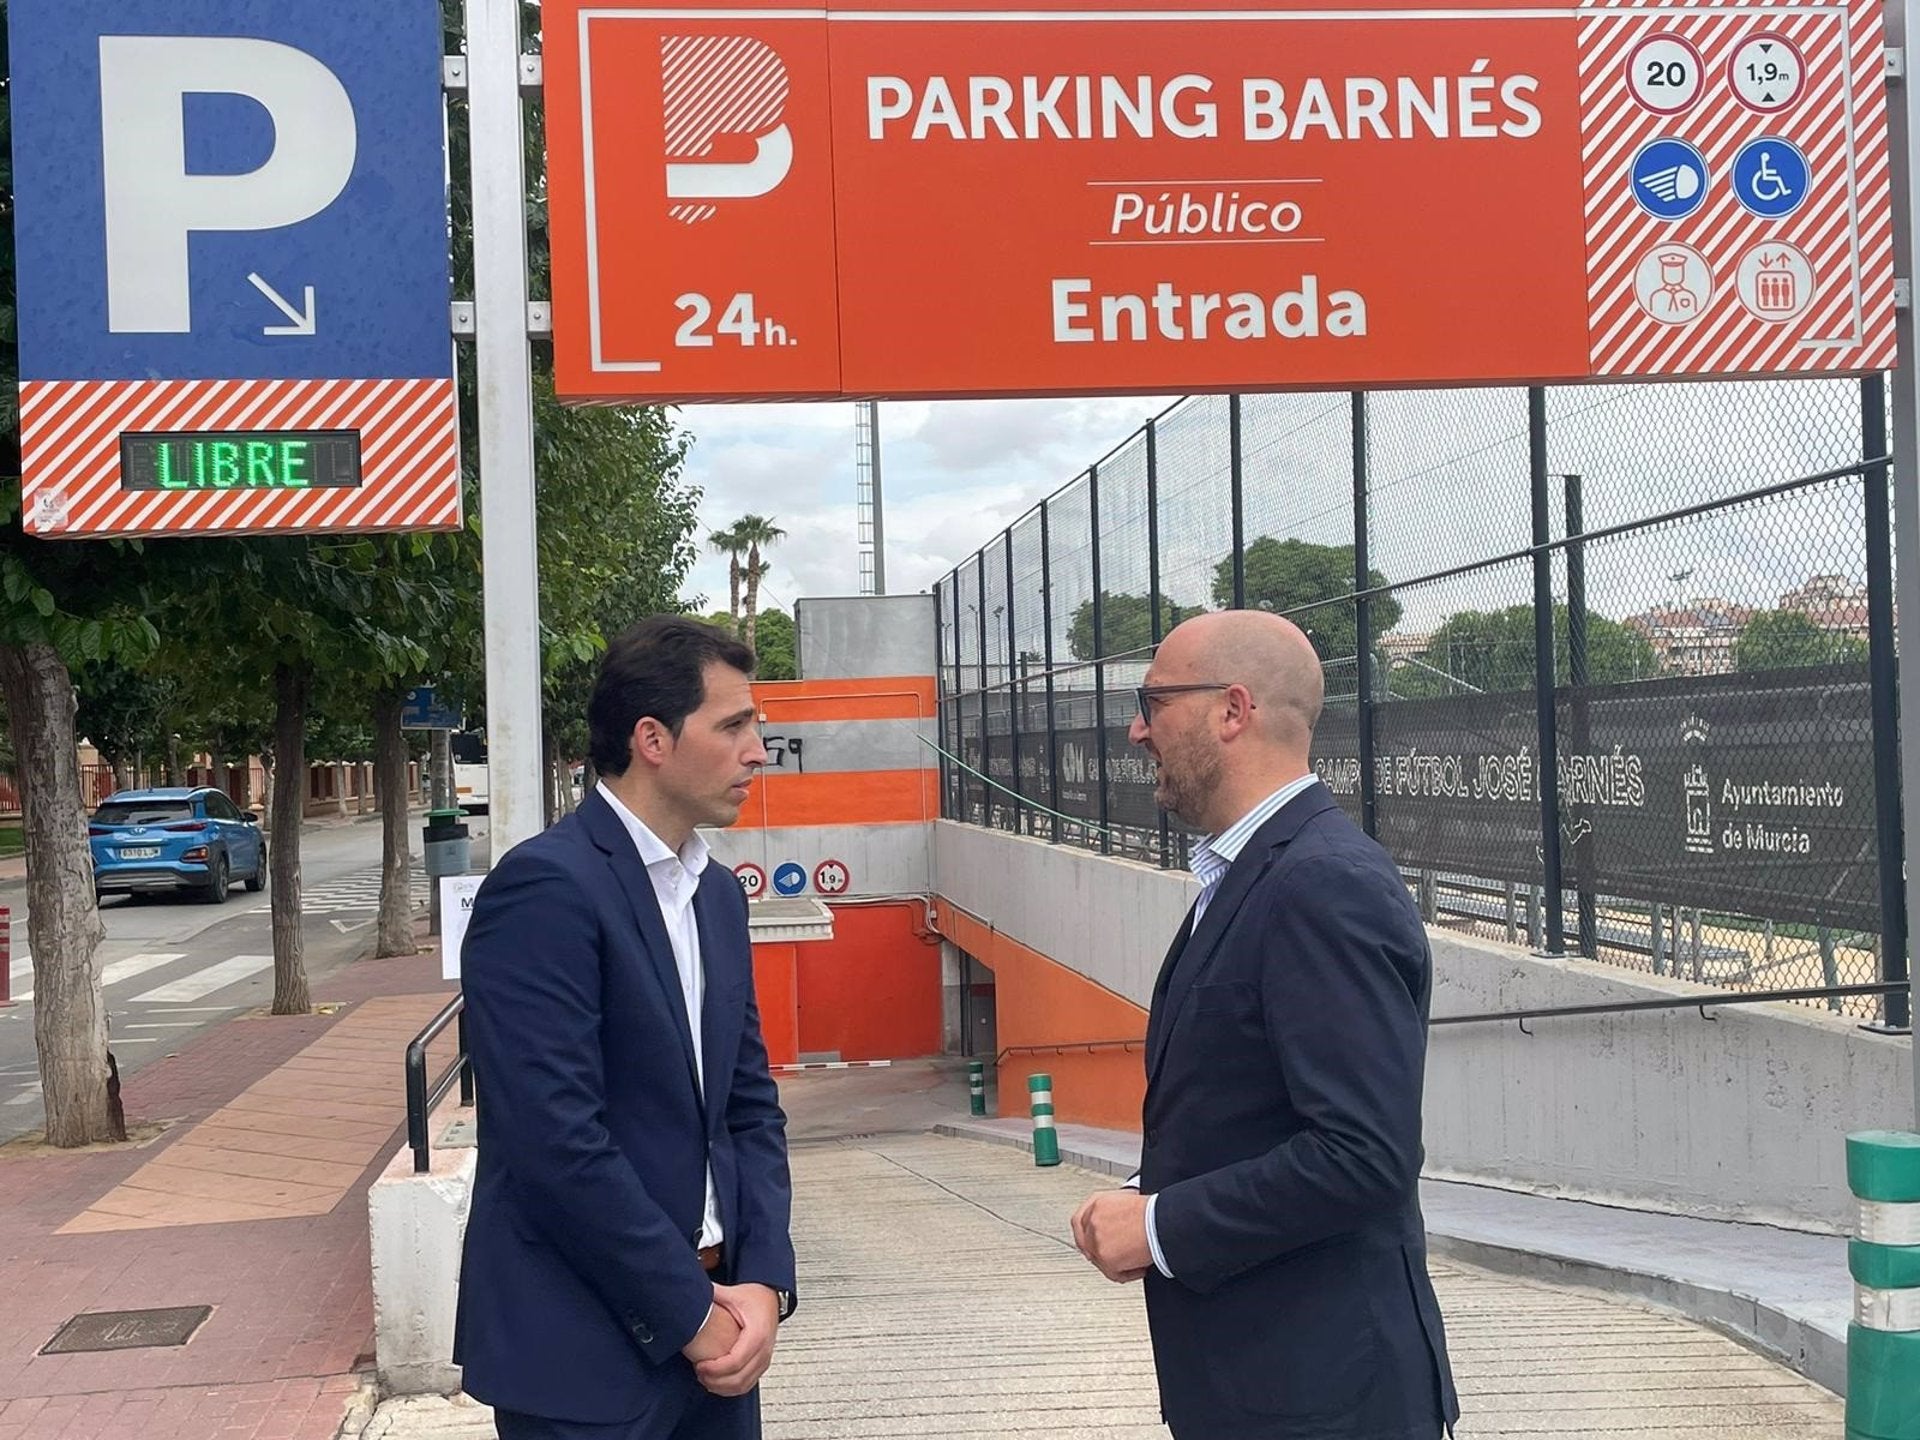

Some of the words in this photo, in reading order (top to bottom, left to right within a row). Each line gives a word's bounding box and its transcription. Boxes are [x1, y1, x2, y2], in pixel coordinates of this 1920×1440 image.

[1646, 62, 1686, 87] 20
[867, 75, 1218, 140] PARKING
[1243, 59, 1542, 141] BARNÉS
[99, 35, 357, 334] P
[1111, 193, 1302, 235] Público
[674, 293, 797, 346] 24h.
[1052, 275, 1367, 342] Entrada
[158, 441, 308, 488] LIBRE
[1315, 757, 1361, 795] CAMP
[1396, 747, 1469, 798] FÚTBOL
[1473, 746, 1532, 801] JOSÉ
[1537, 745, 1645, 806] ARNÉS
[1722, 778, 1843, 811] Ayuntamiento
[1722, 823, 1742, 849] de
[1746, 824, 1811, 853] Murcia
